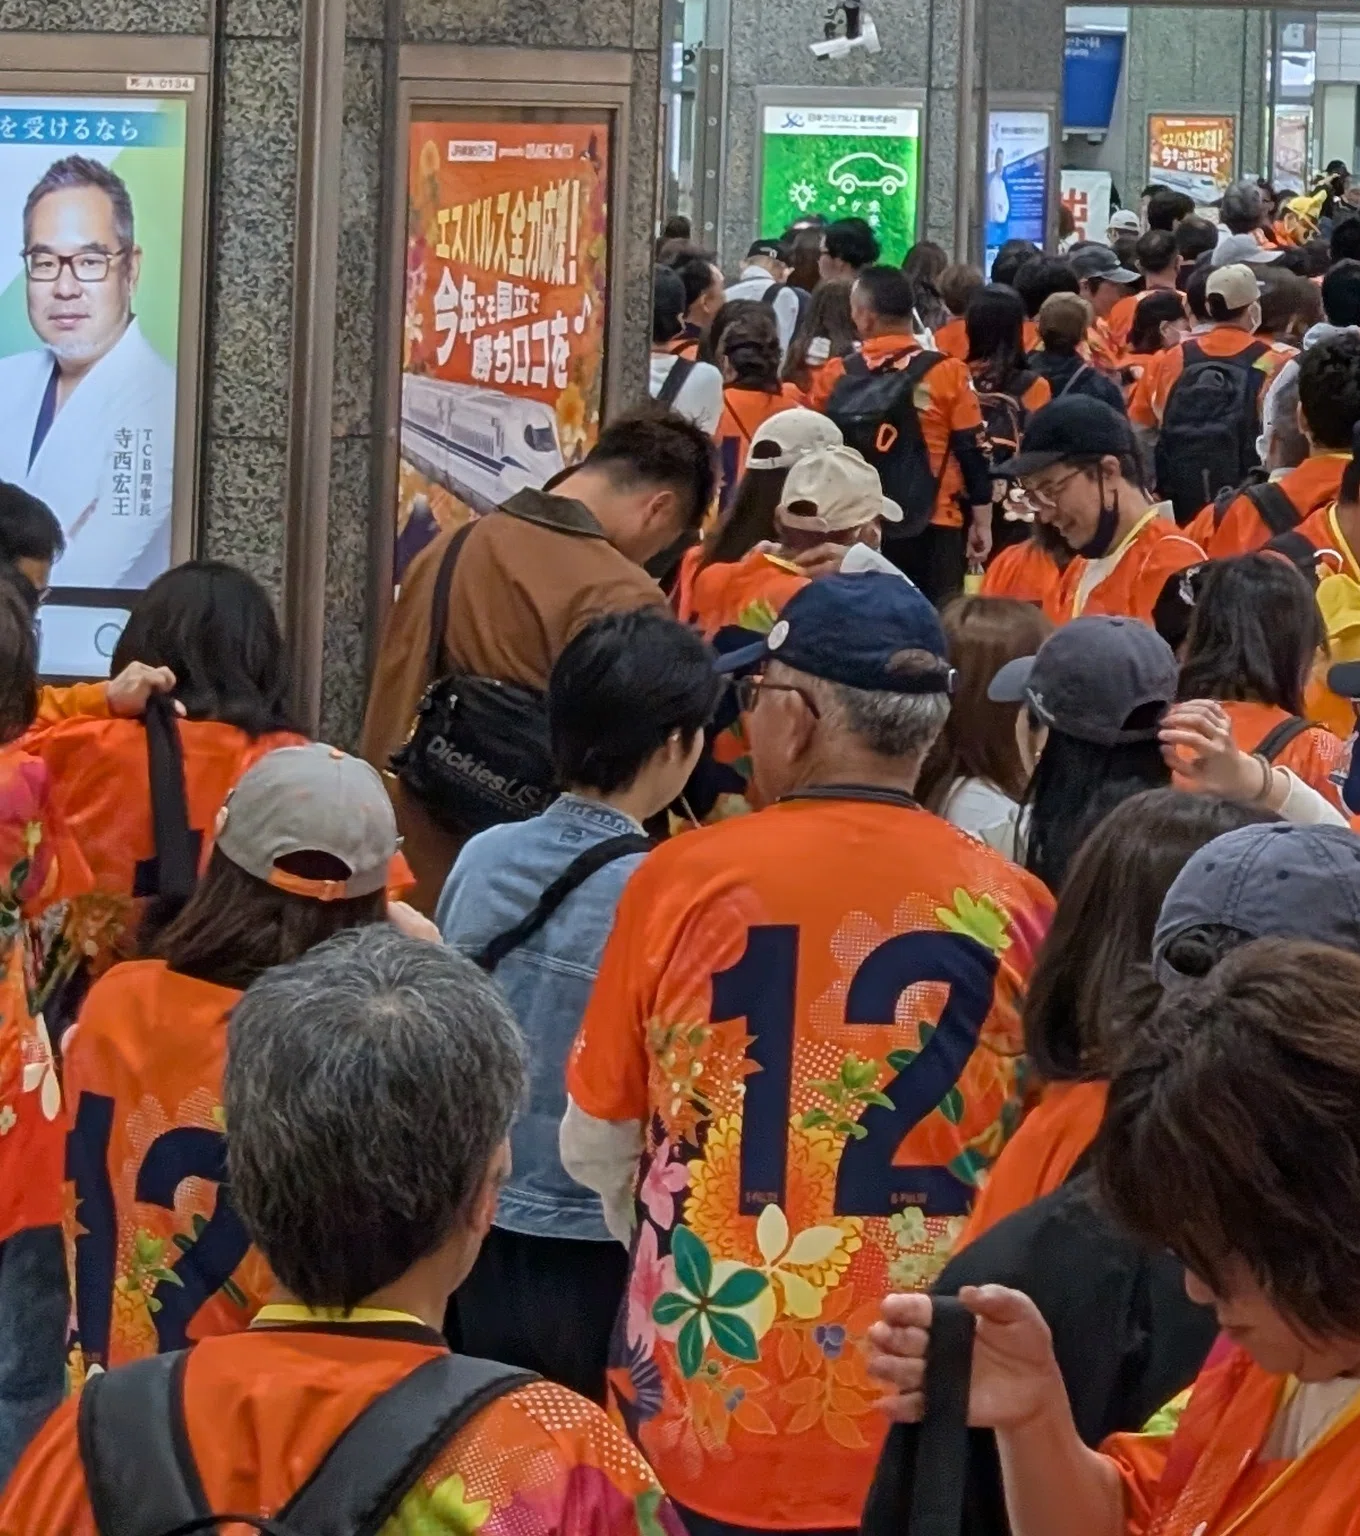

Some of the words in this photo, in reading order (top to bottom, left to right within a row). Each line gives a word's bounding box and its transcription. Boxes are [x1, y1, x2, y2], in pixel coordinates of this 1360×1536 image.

[0, 115, 140, 142] を受けるなら
[111, 427, 133, 516] 寺西宏王
[711, 924, 998, 1217] 12
